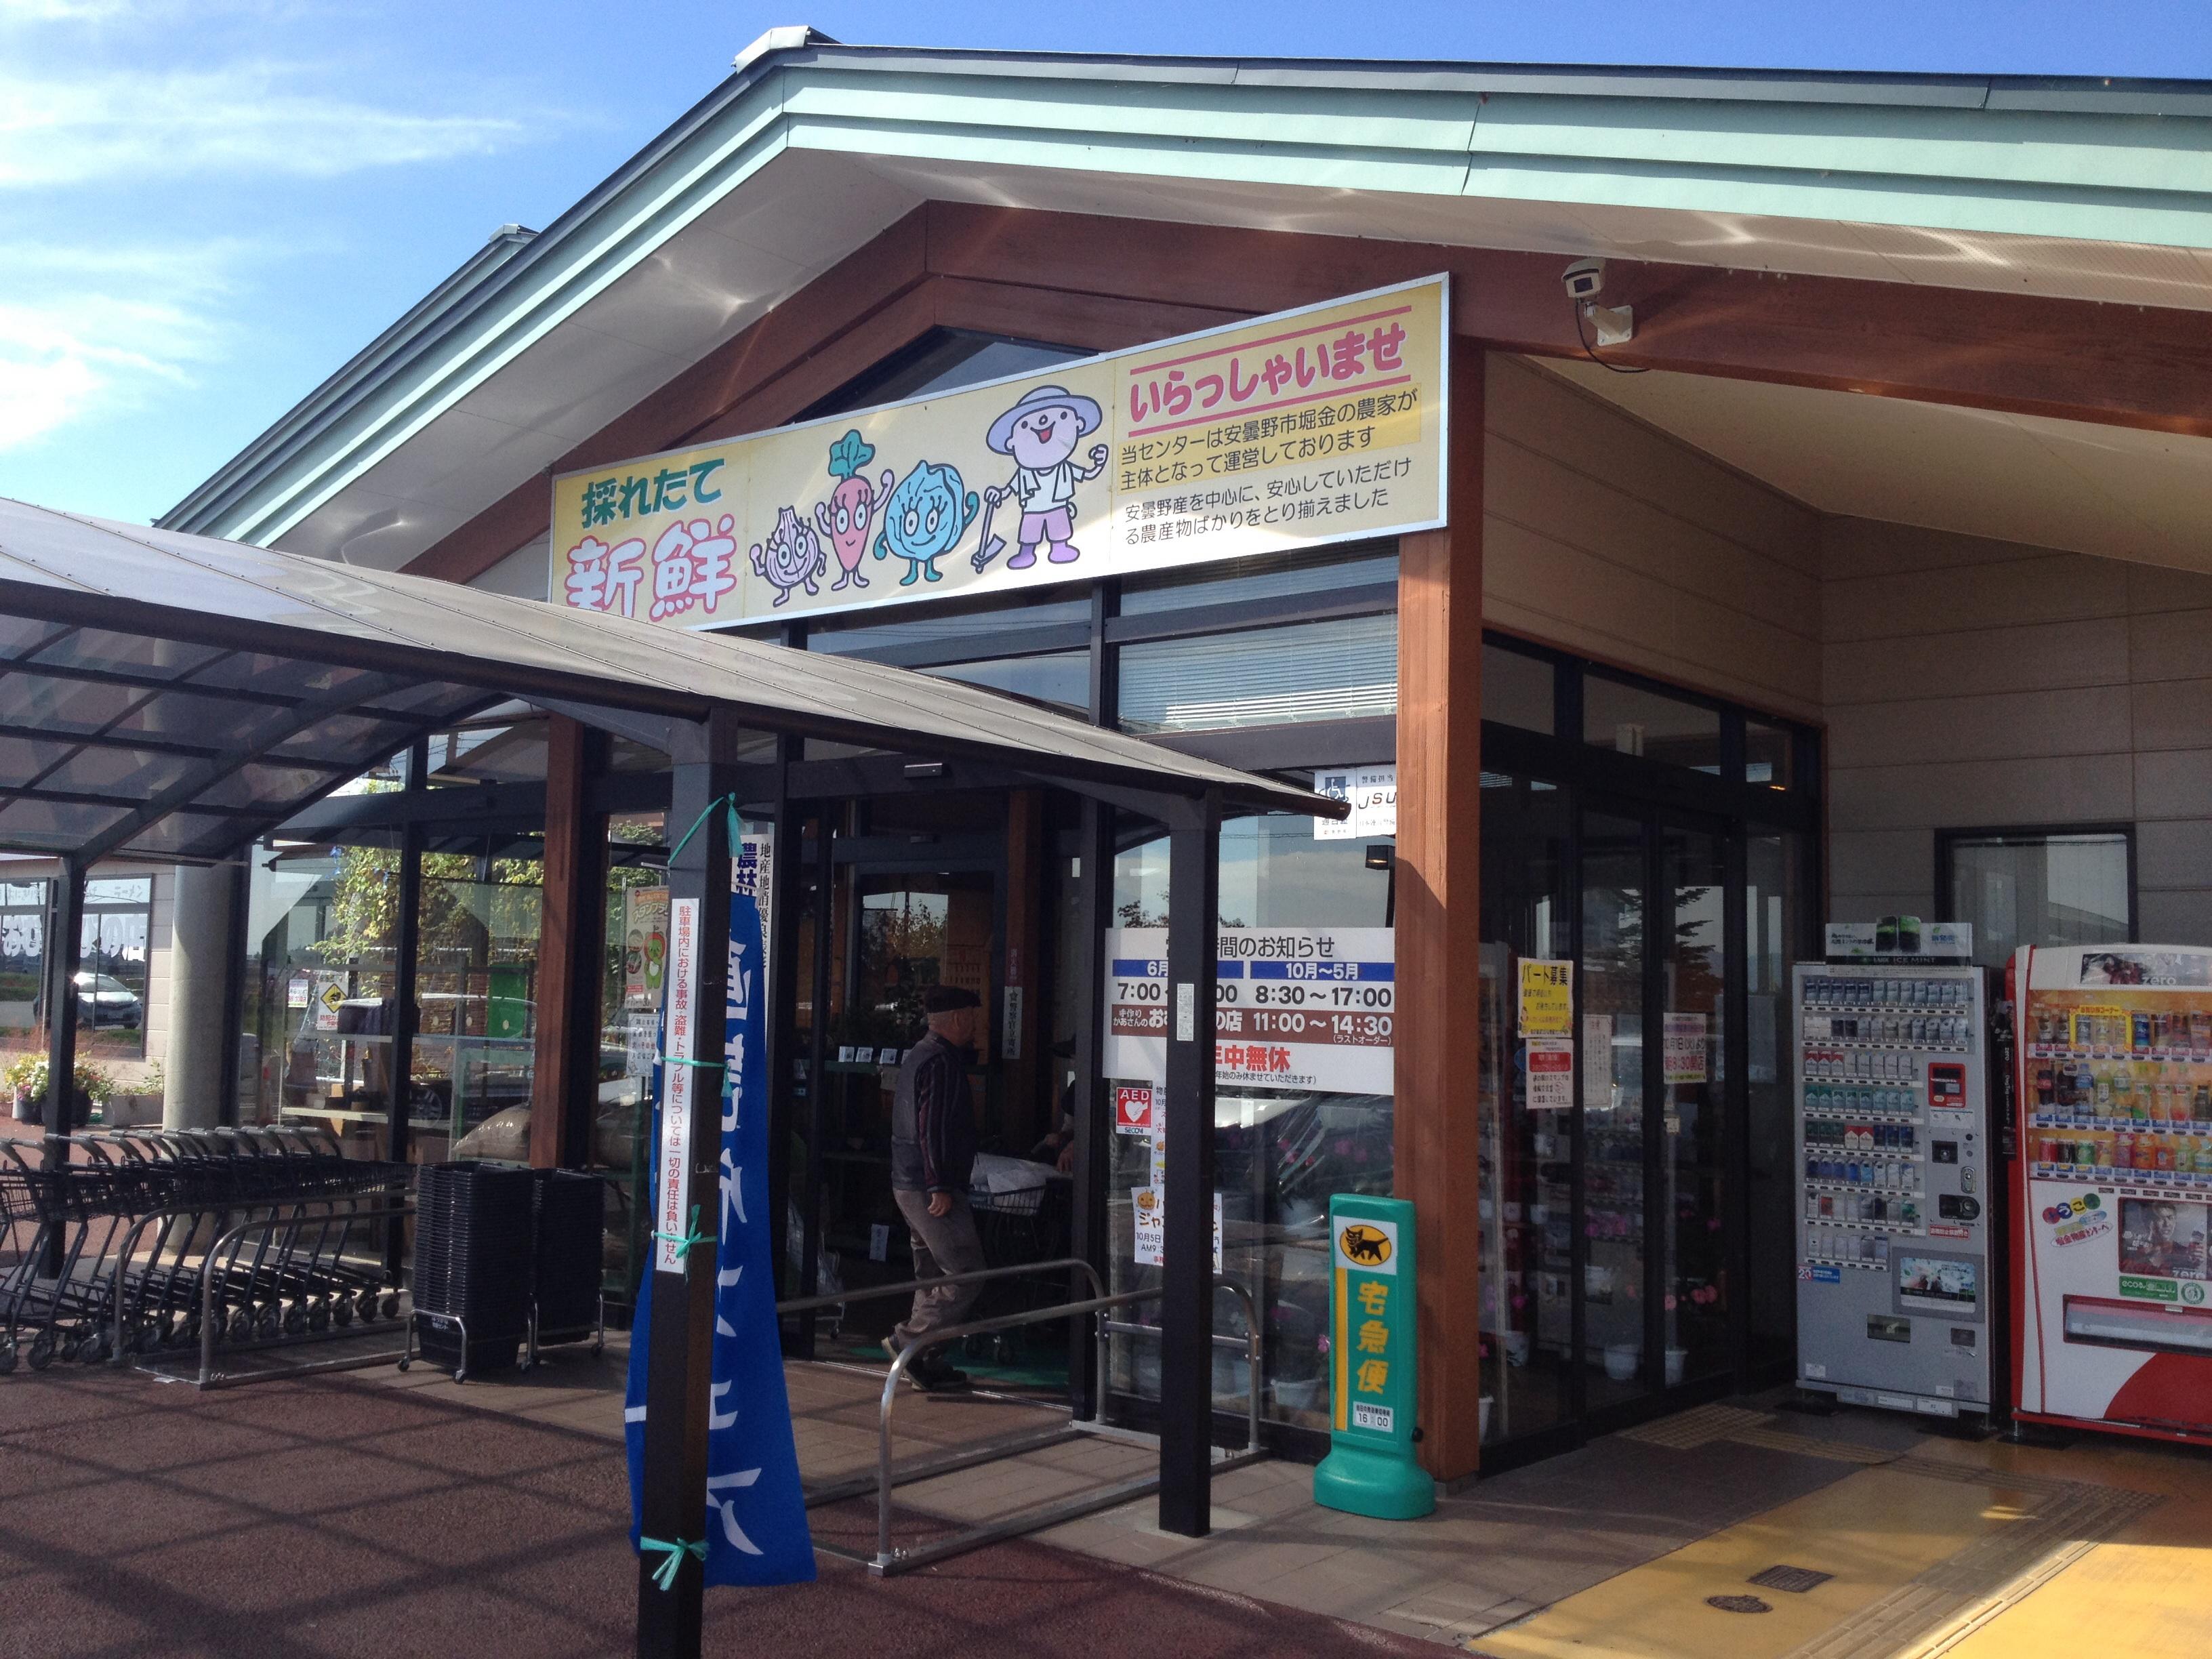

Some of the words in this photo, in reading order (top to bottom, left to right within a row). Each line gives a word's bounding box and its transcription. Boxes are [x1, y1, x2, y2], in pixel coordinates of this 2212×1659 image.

[1130, 321, 1407, 424] いらっしゃいませ
[1121, 388, 1418, 466] 当センターは安曇野市堀金の農家が
[1120, 425, 1376, 491] 主体となって運営しております
[581, 457, 725, 529] 採れたて
[1125, 457, 1412, 523] 安曇野産を中心に、安心していただけ
[1126, 487, 1389, 545] る農産物ばかりをとり揃えました
[565, 513, 737, 622] 新鮮
[1166, 935, 1335, 958] 間のお知らせ
[1286, 962, 1359, 981] 10月～5月
[1112, 1017, 1148, 1028] かあさんの
[1119, 1008, 1142, 1019] 手作り
[1120, 1089, 1150, 1101] AED
[1136, 1232, 1161, 1244] 10月5日
[1139, 1211, 1165, 1228] ジャ
[1357, 1280, 1389, 1395] 宅急便
